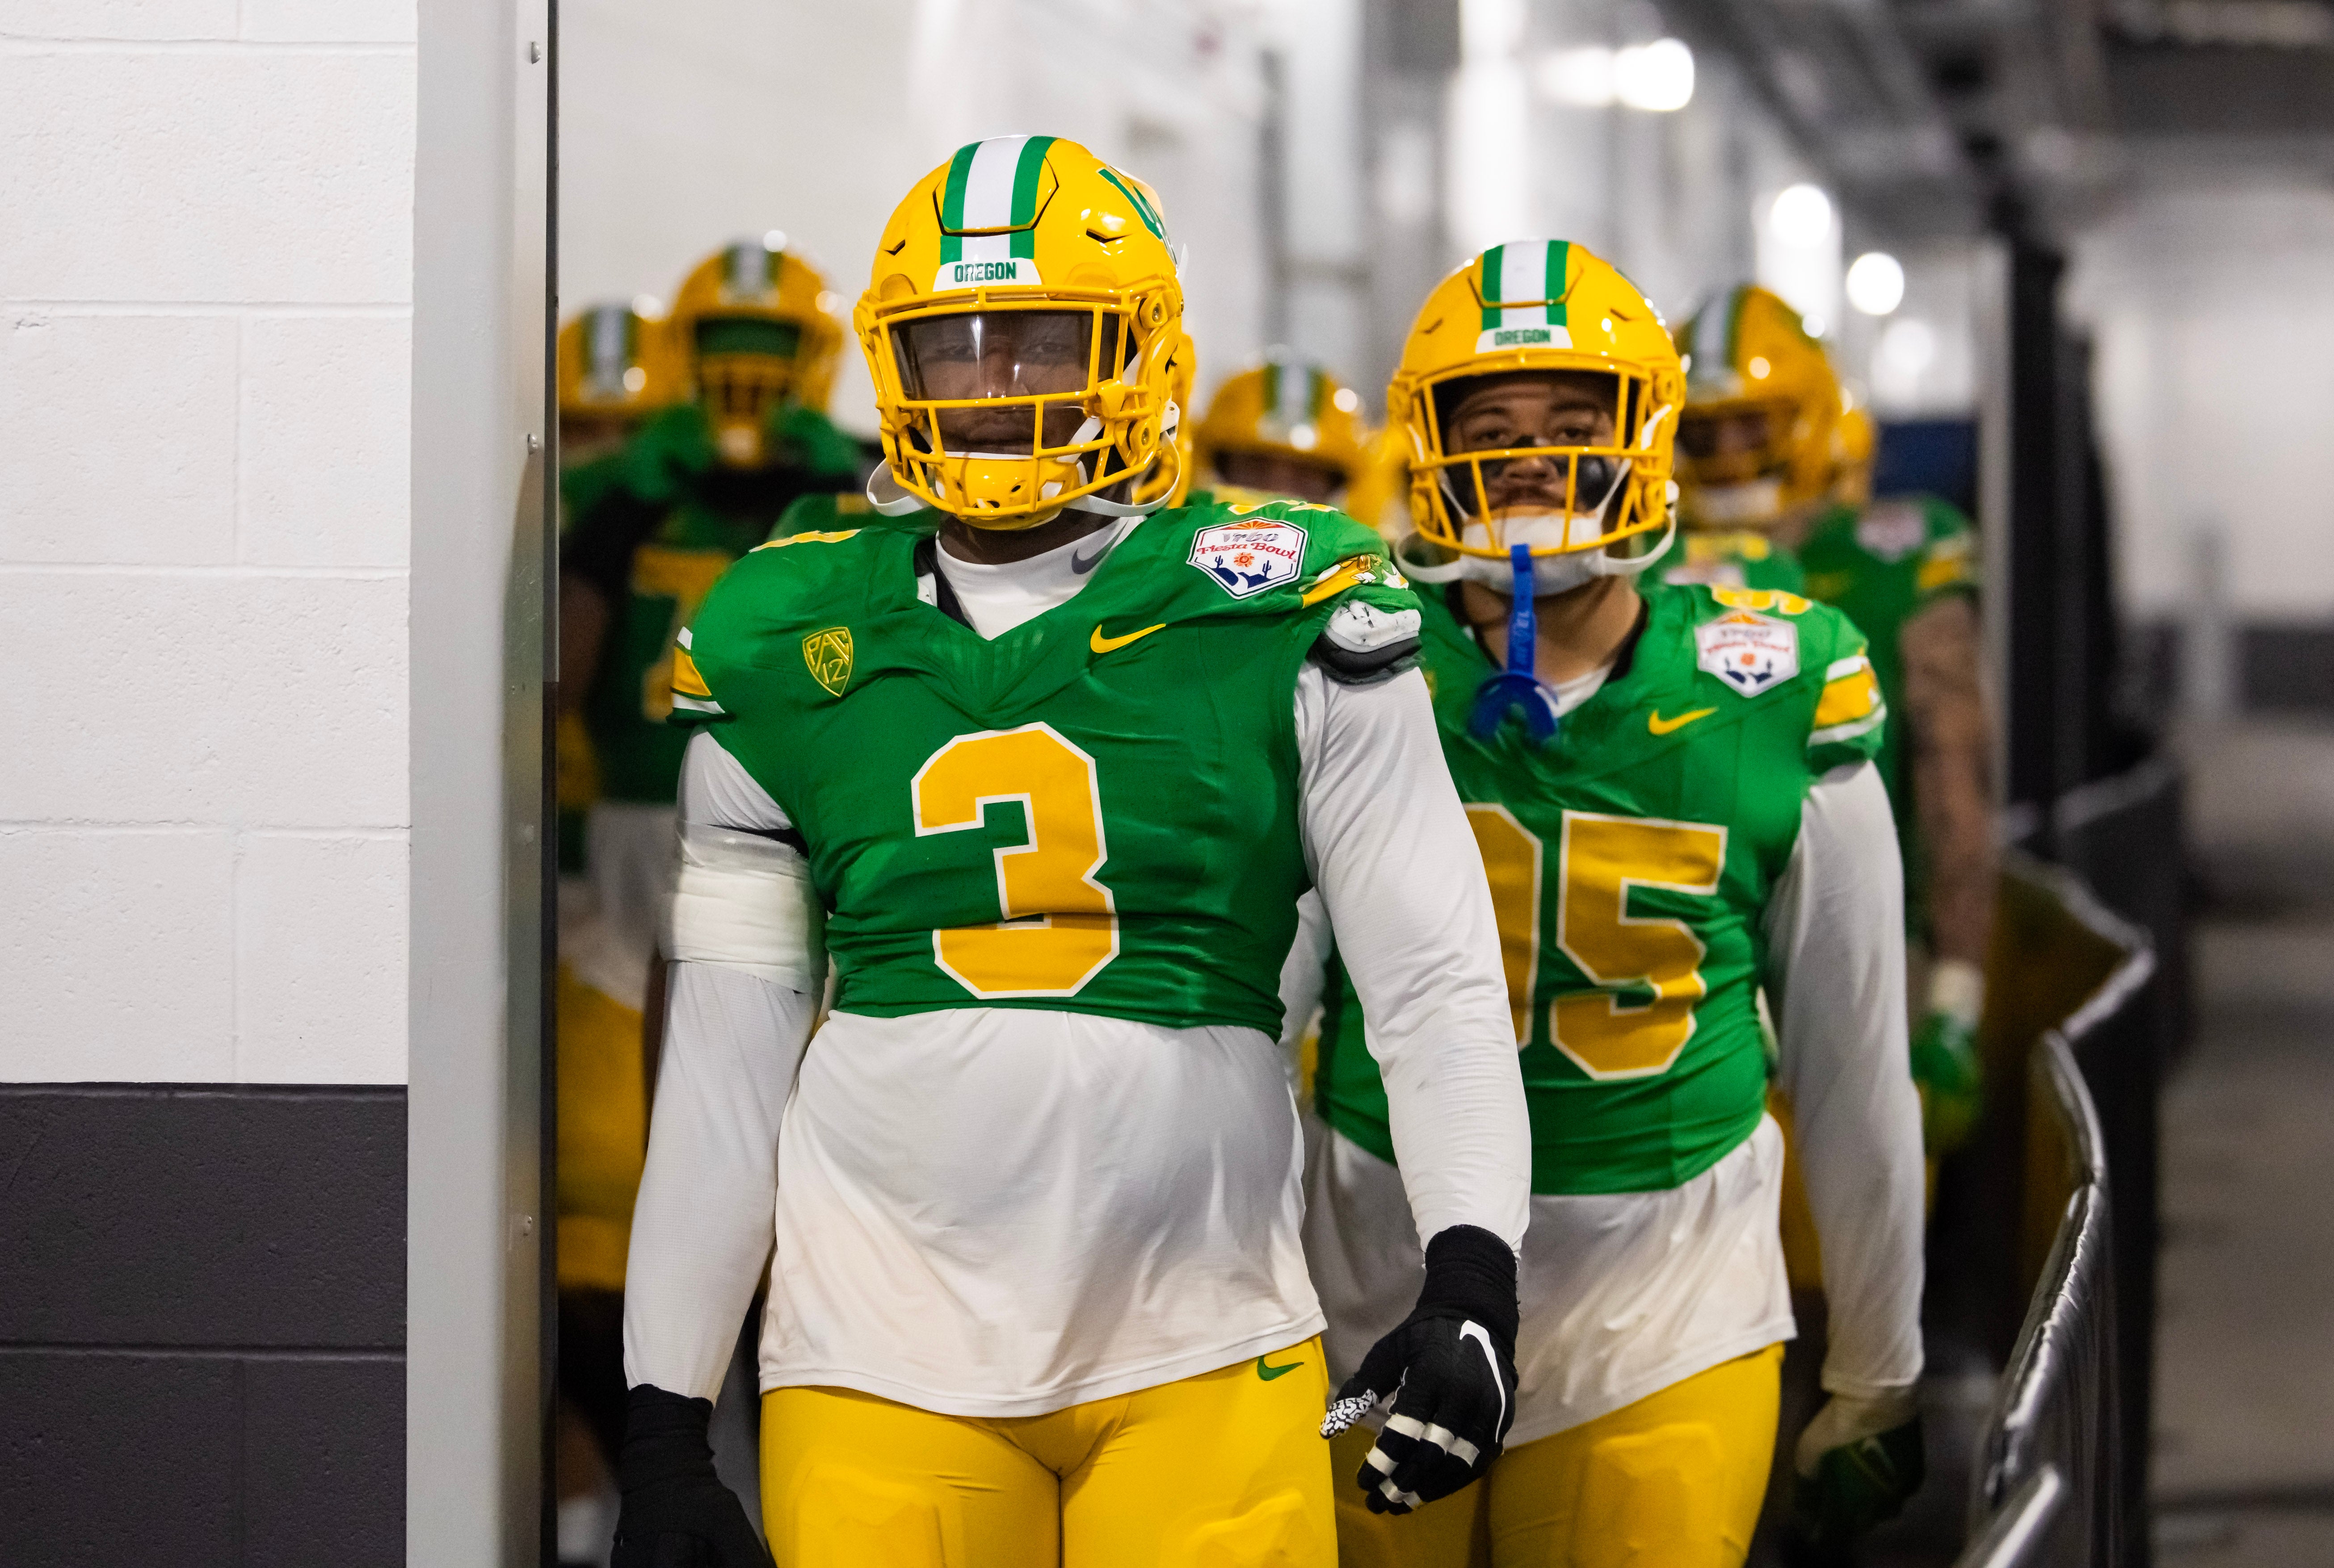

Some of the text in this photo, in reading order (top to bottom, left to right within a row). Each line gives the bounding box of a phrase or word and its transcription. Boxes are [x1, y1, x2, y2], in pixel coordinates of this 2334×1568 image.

[954, 262, 1017, 282] OREGON
[1197, 542, 1297, 559] Fiesta Bowl
[806, 631, 849, 673] PAC
[823, 658, 846, 684] 12
[911, 721, 1120, 999] 3
